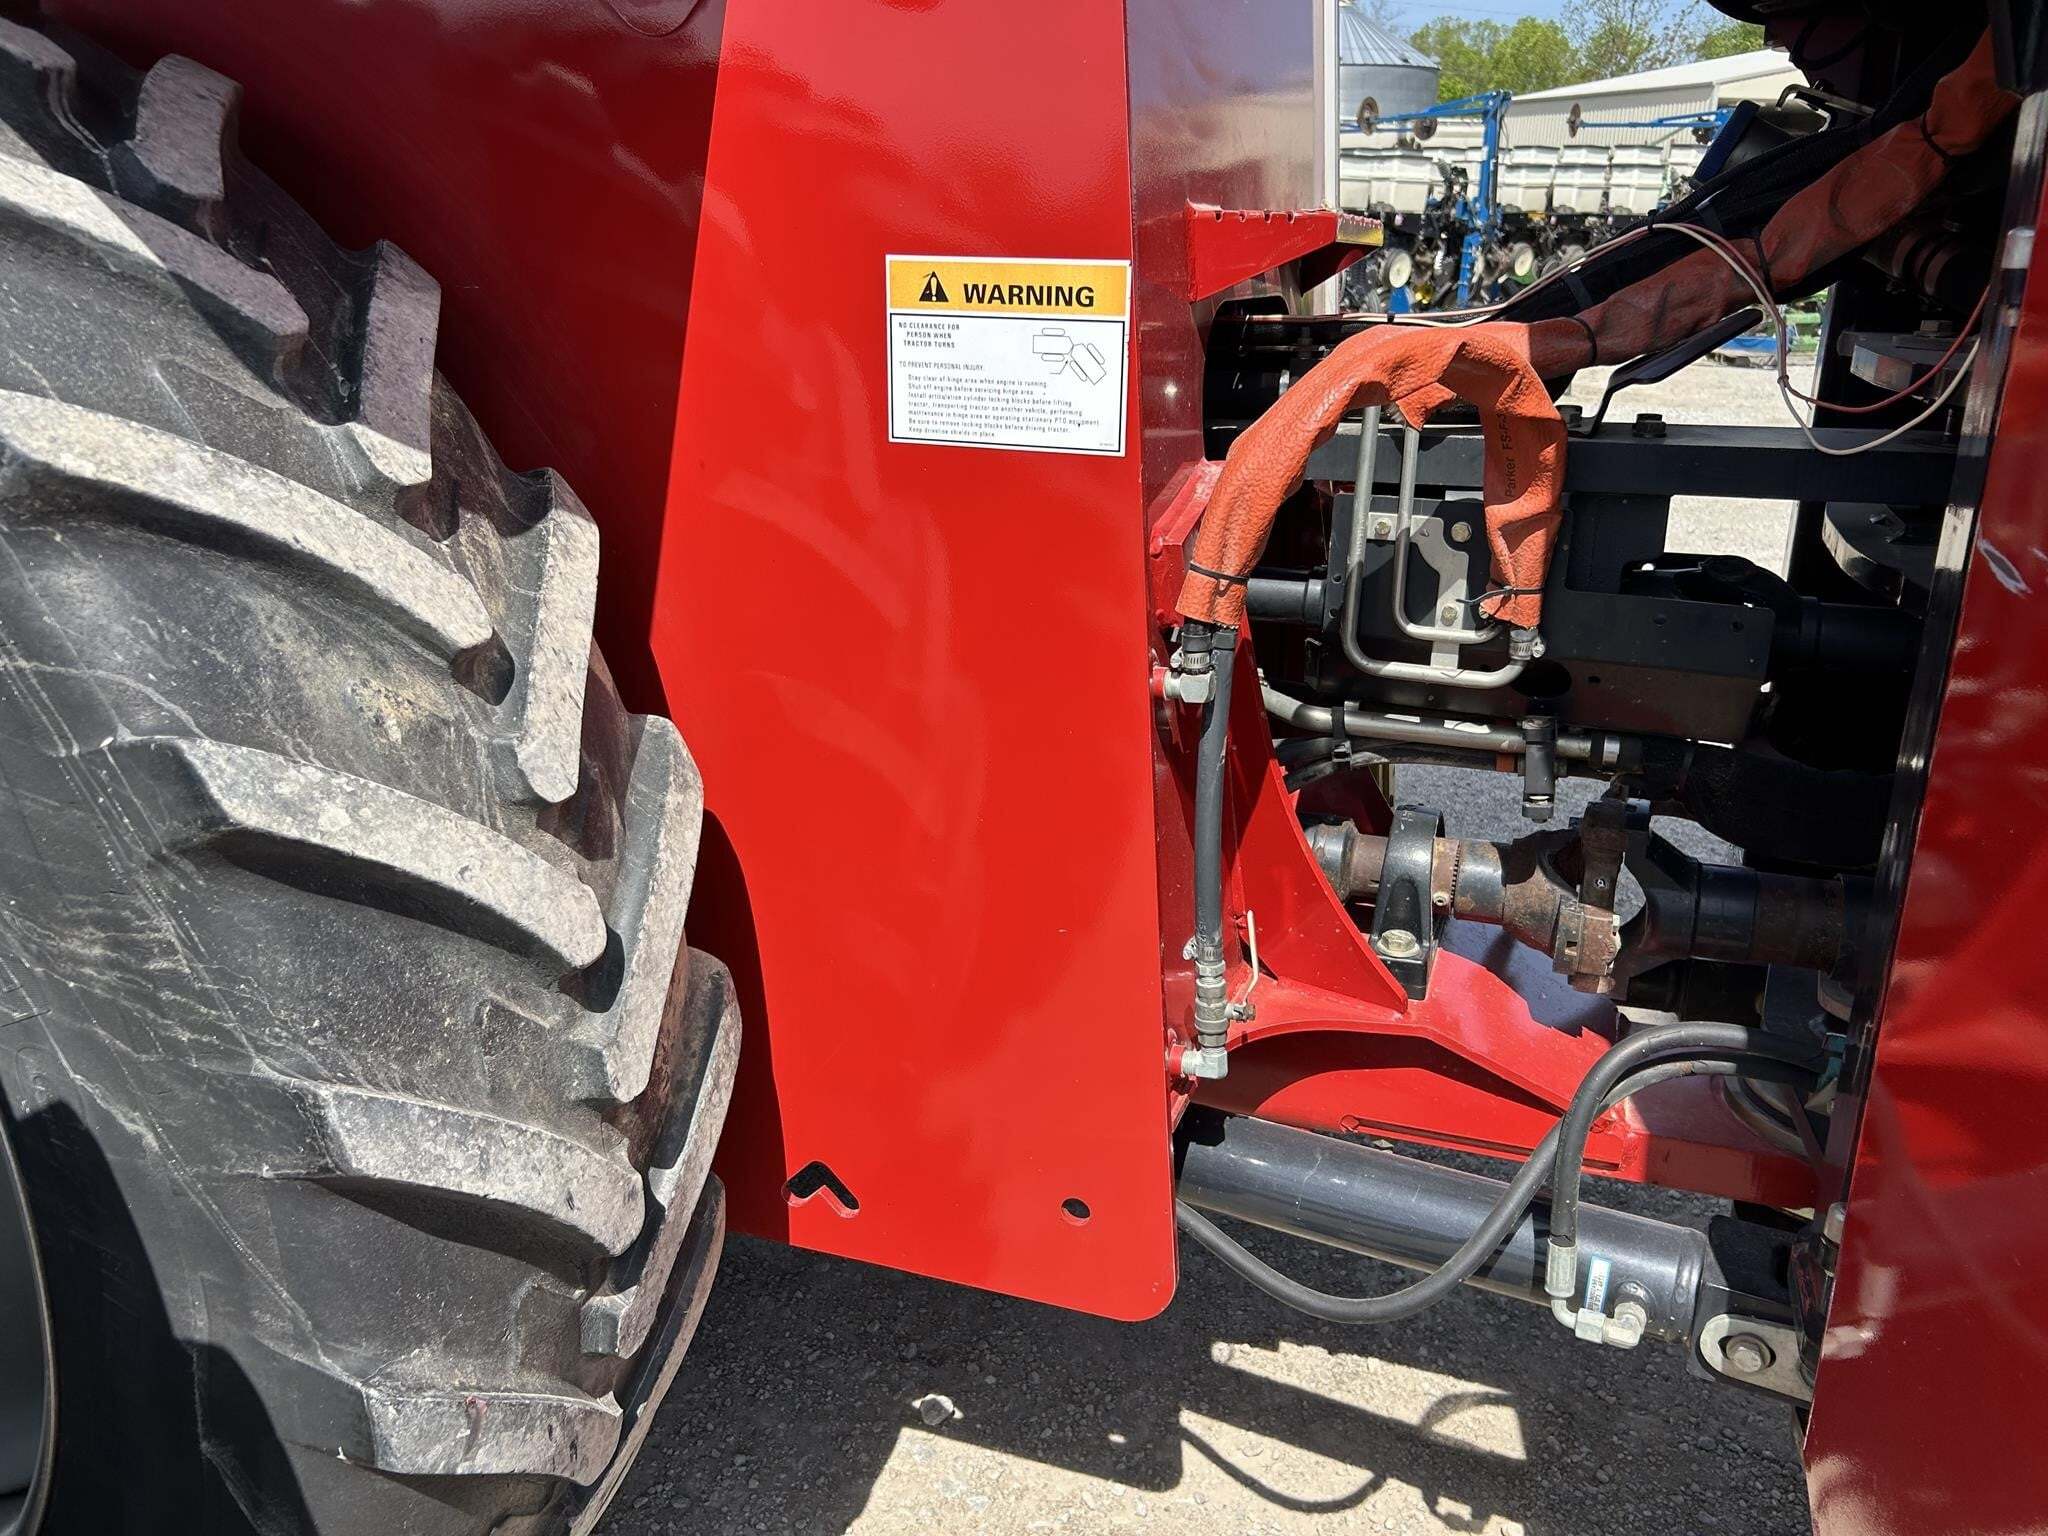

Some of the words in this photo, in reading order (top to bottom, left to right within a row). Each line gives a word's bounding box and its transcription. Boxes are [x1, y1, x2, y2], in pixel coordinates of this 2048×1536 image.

[963, 283, 1094, 307] WARNING
[934, 362, 961, 370] PERSONAL
[908, 374, 921, 382] Stay
[948, 375, 962, 384] hinge
[997, 378, 1015, 387] engine
[933, 384, 952, 393] engine
[975, 386, 1001, 395] servicing
[1003, 387, 1018, 396] hinge
[909, 391, 927, 399] Install
[929, 392, 961, 400] articulation
[964, 394, 986, 403] cylinder
[989, 395, 1009, 404] locking
[1054, 399, 1072, 408] lifting
[933, 402, 968, 411] transporting
[1050, 408, 1083, 417] performing
[993, 414, 1020, 422] operating
[1023, 415, 1052, 424] stationary
[909, 426, 922, 434] Keep
[962, 421, 982, 429] locking
[1026, 425, 1046, 433] driving
[1504, 456, 1516, 498] Parker
